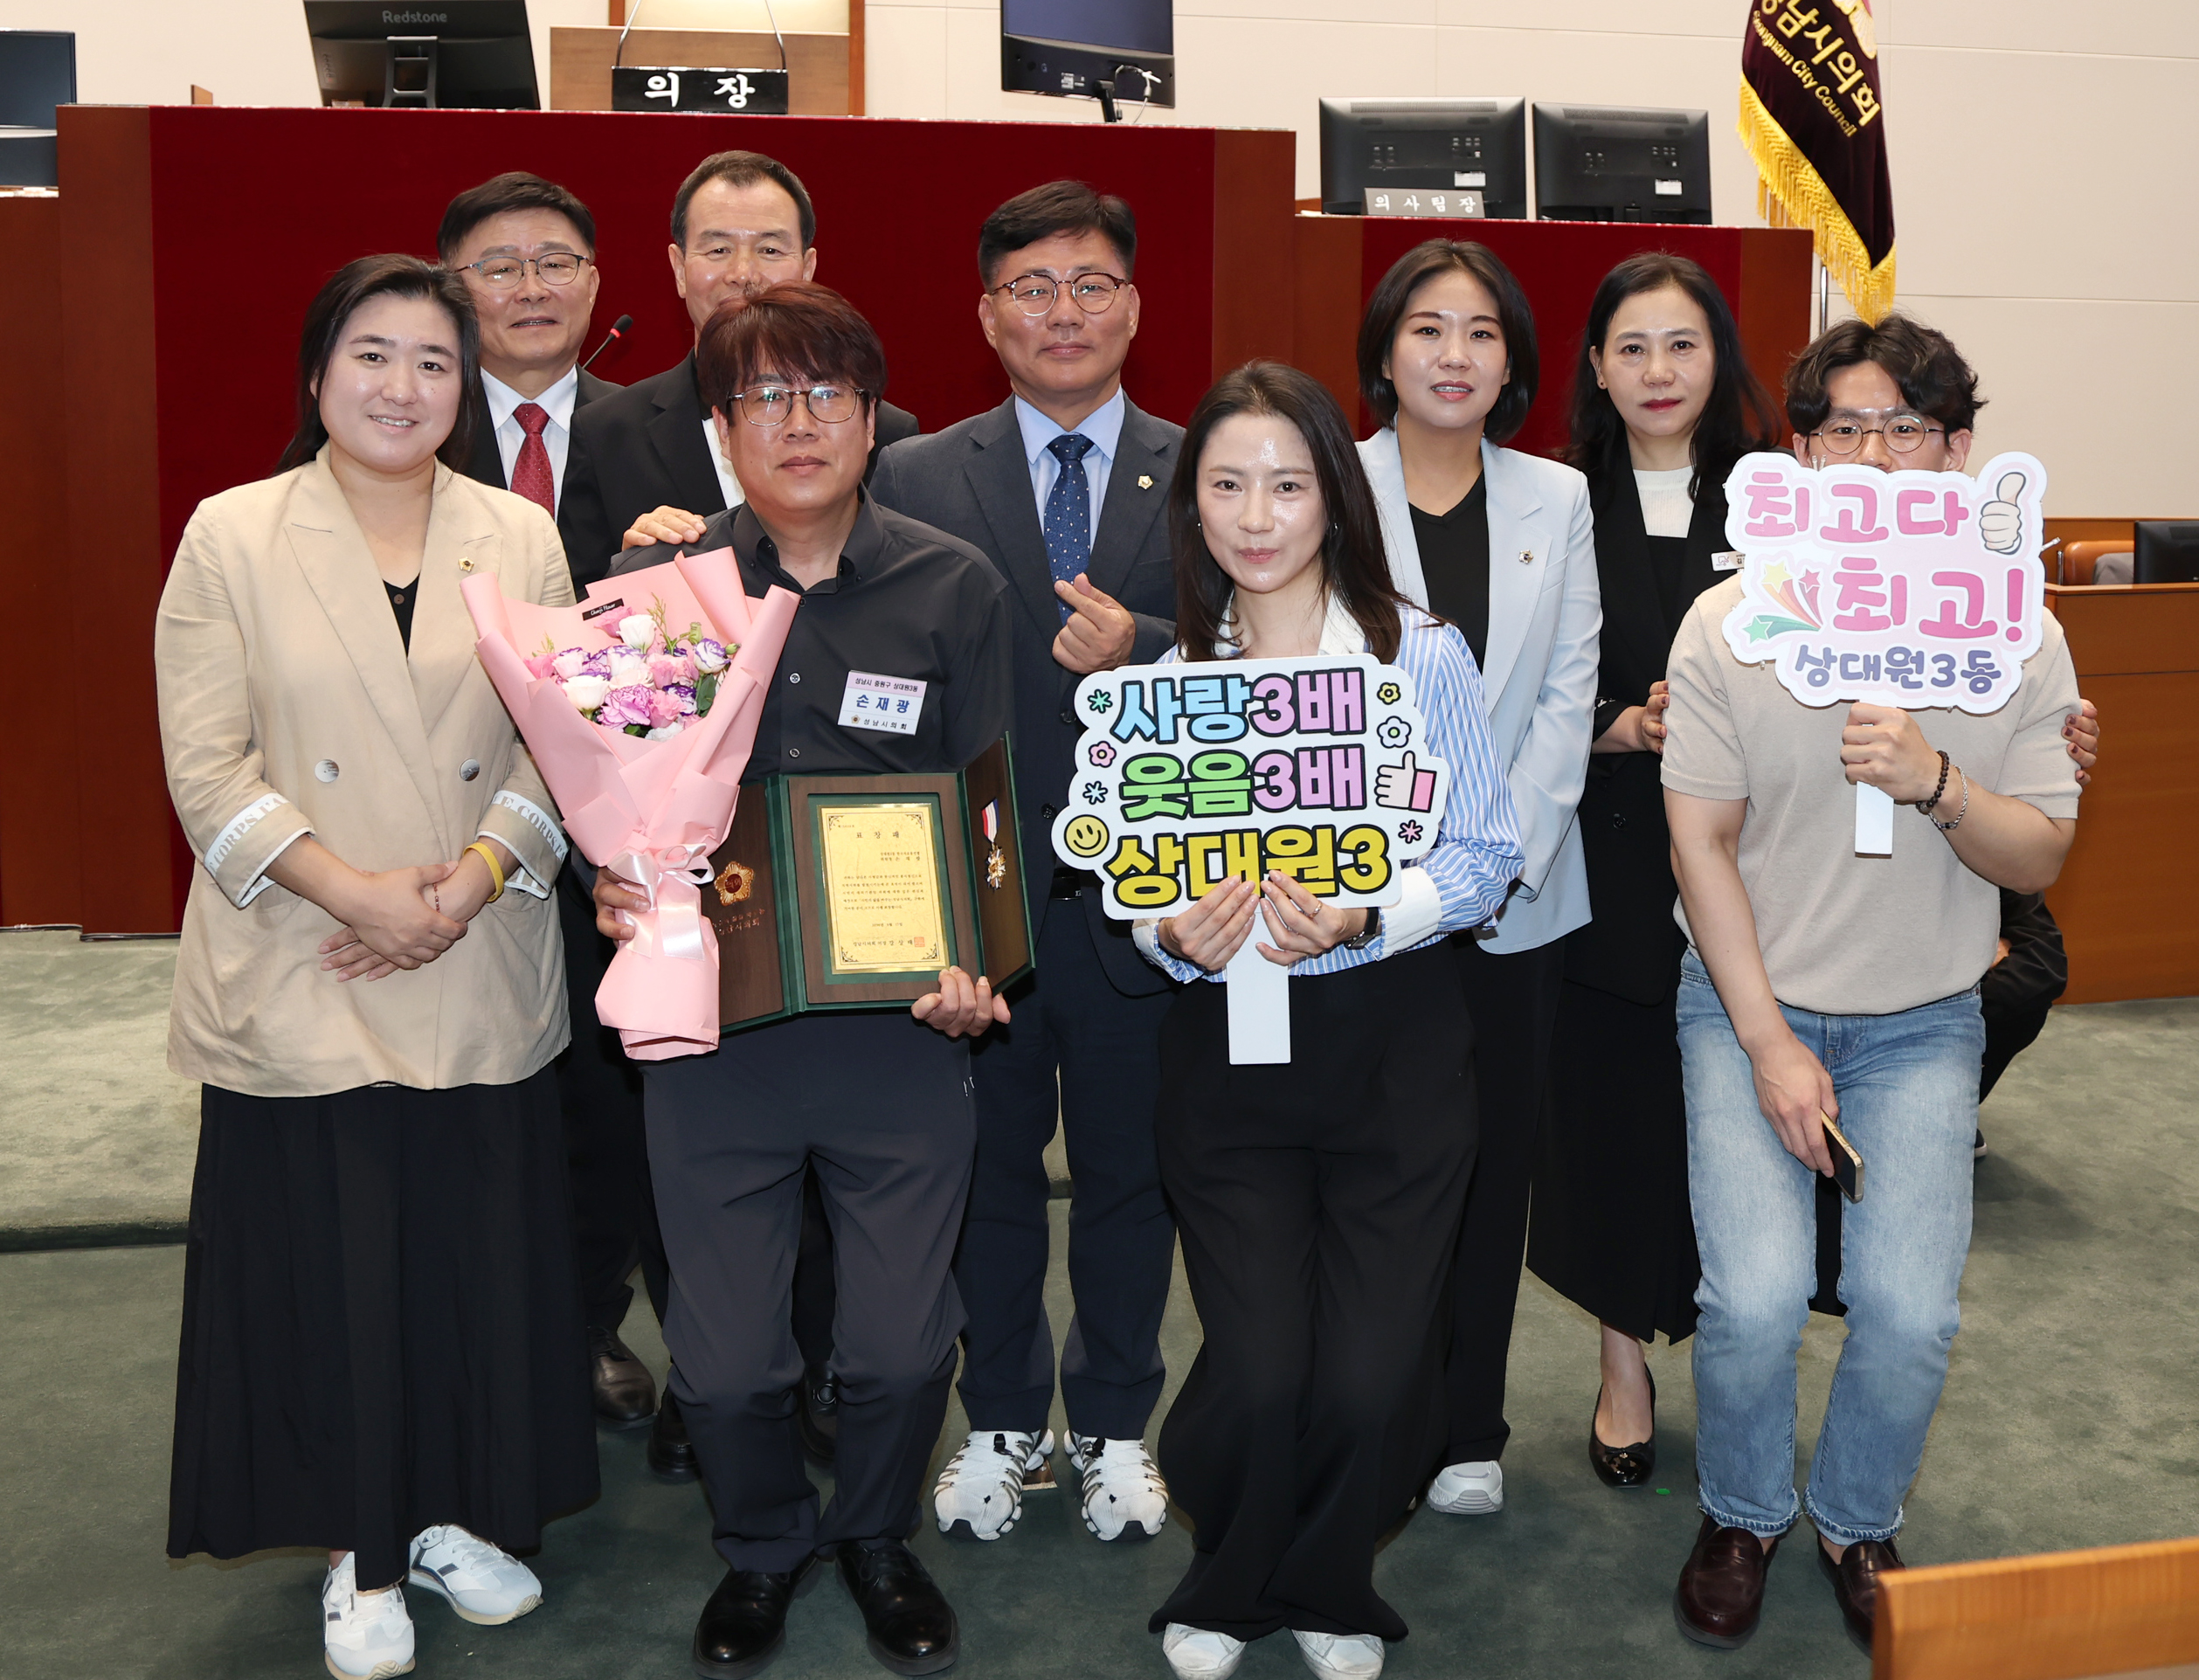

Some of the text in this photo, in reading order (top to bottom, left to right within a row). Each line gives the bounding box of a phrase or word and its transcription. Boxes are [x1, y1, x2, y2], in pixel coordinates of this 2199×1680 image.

[382, 10, 448, 24] Redstone
[1792, 59, 1818, 89] City
[1815, 86, 1858, 137] Council
[1745, 472, 1969, 543] 최고다
[854, 677, 873, 687] 성남시
[893, 683, 919, 693] 상대원3동
[1794, 645, 2002, 695] 상대원3동
[1110, 667, 1367, 744] 사랑3배
[1118, 743, 1368, 823] 웃음3배
[213, 813, 259, 866] CORPS
[517, 805, 558, 848] CORPS
[1104, 824, 1393, 909] 상대원3
